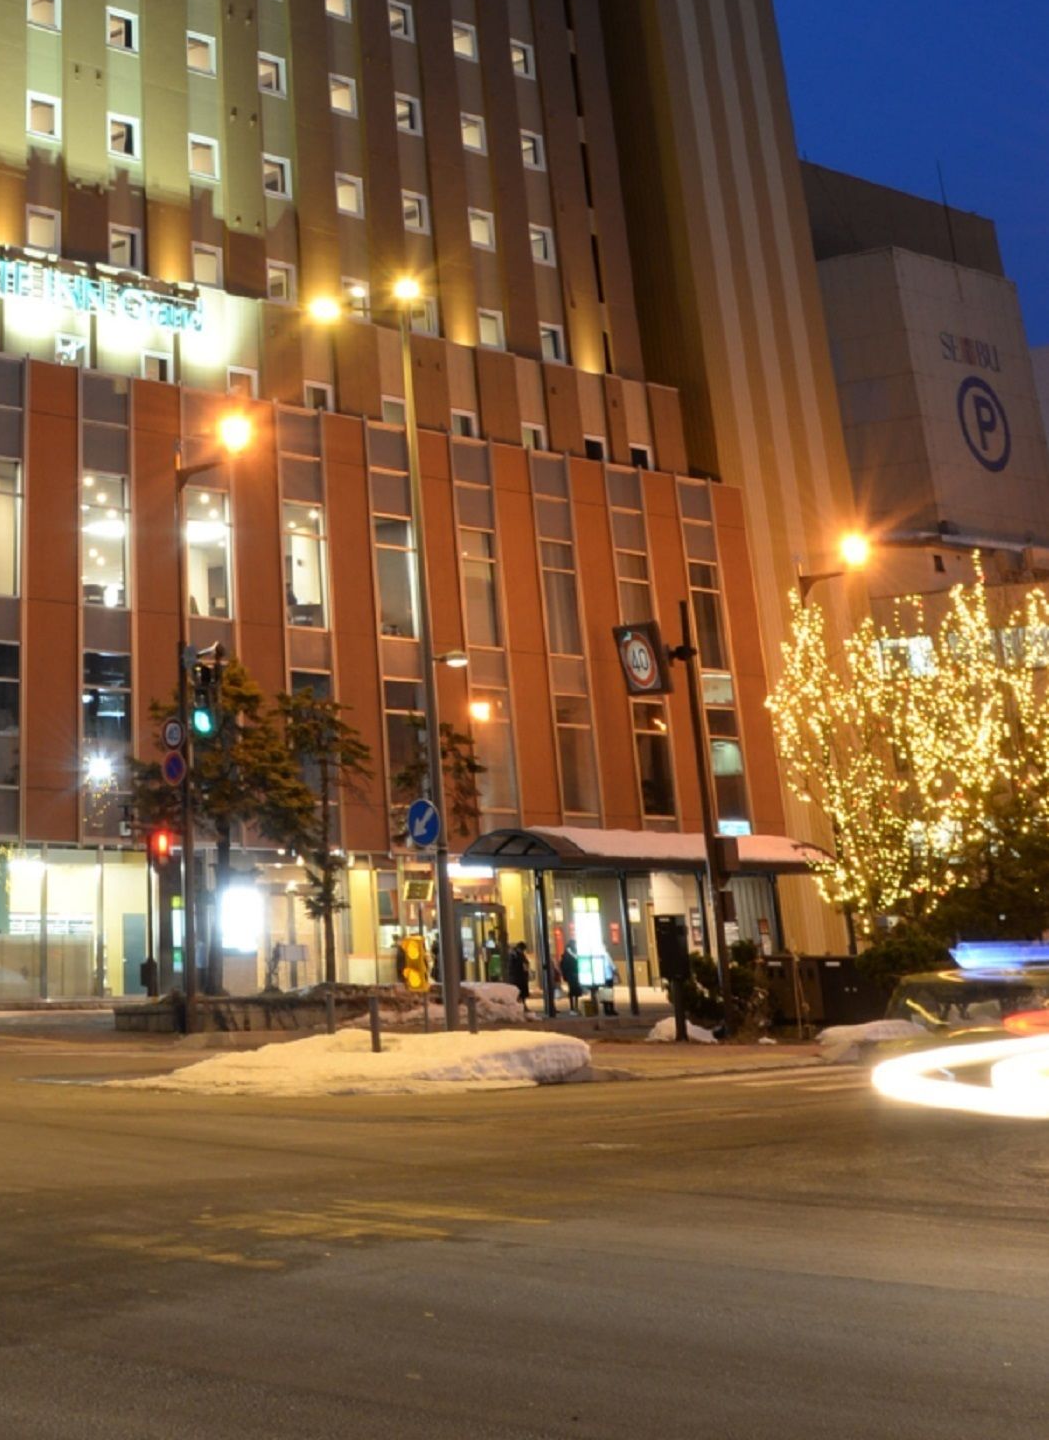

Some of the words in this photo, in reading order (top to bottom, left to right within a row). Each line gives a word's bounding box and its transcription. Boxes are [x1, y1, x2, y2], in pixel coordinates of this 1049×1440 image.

[118, 286, 204, 332] Grand
[939, 330, 1001, 373] SEIBU
[972, 394, 997, 452] P
[632, 647, 649, 673] 40
